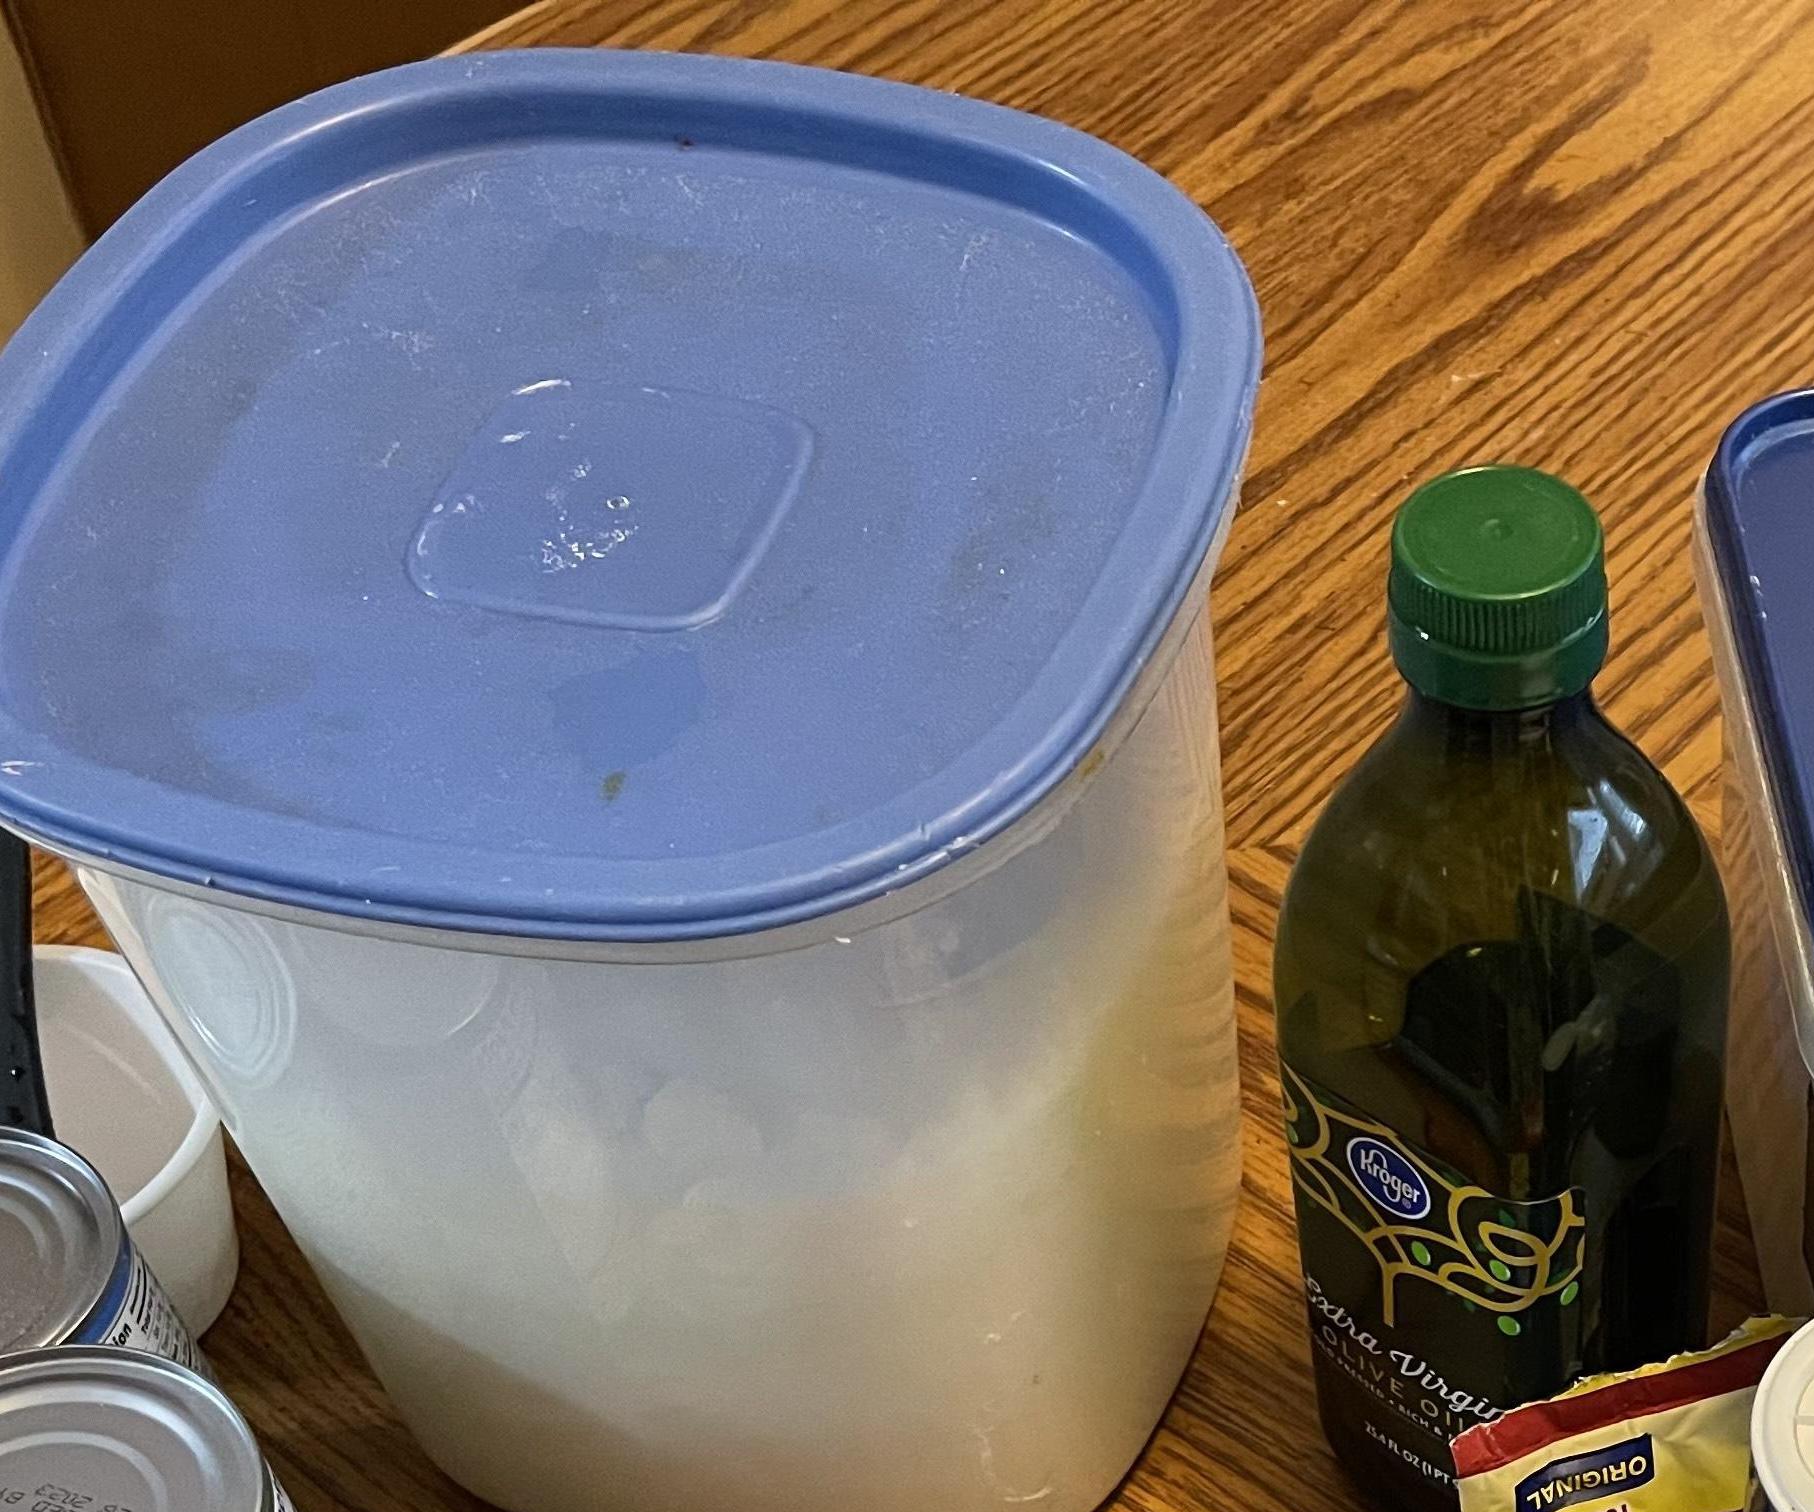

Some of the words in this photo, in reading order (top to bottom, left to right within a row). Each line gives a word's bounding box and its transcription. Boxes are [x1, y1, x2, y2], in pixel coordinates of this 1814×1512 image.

[1360, 1149, 1420, 1203] Kroger
[1306, 1272, 1383, 1356] Extra
[1322, 1325, 1404, 1399] OLIVE
[35, 1483, 94, 1509] 2023
[1526, 1455, 1648, 1510] ORIGINAL
